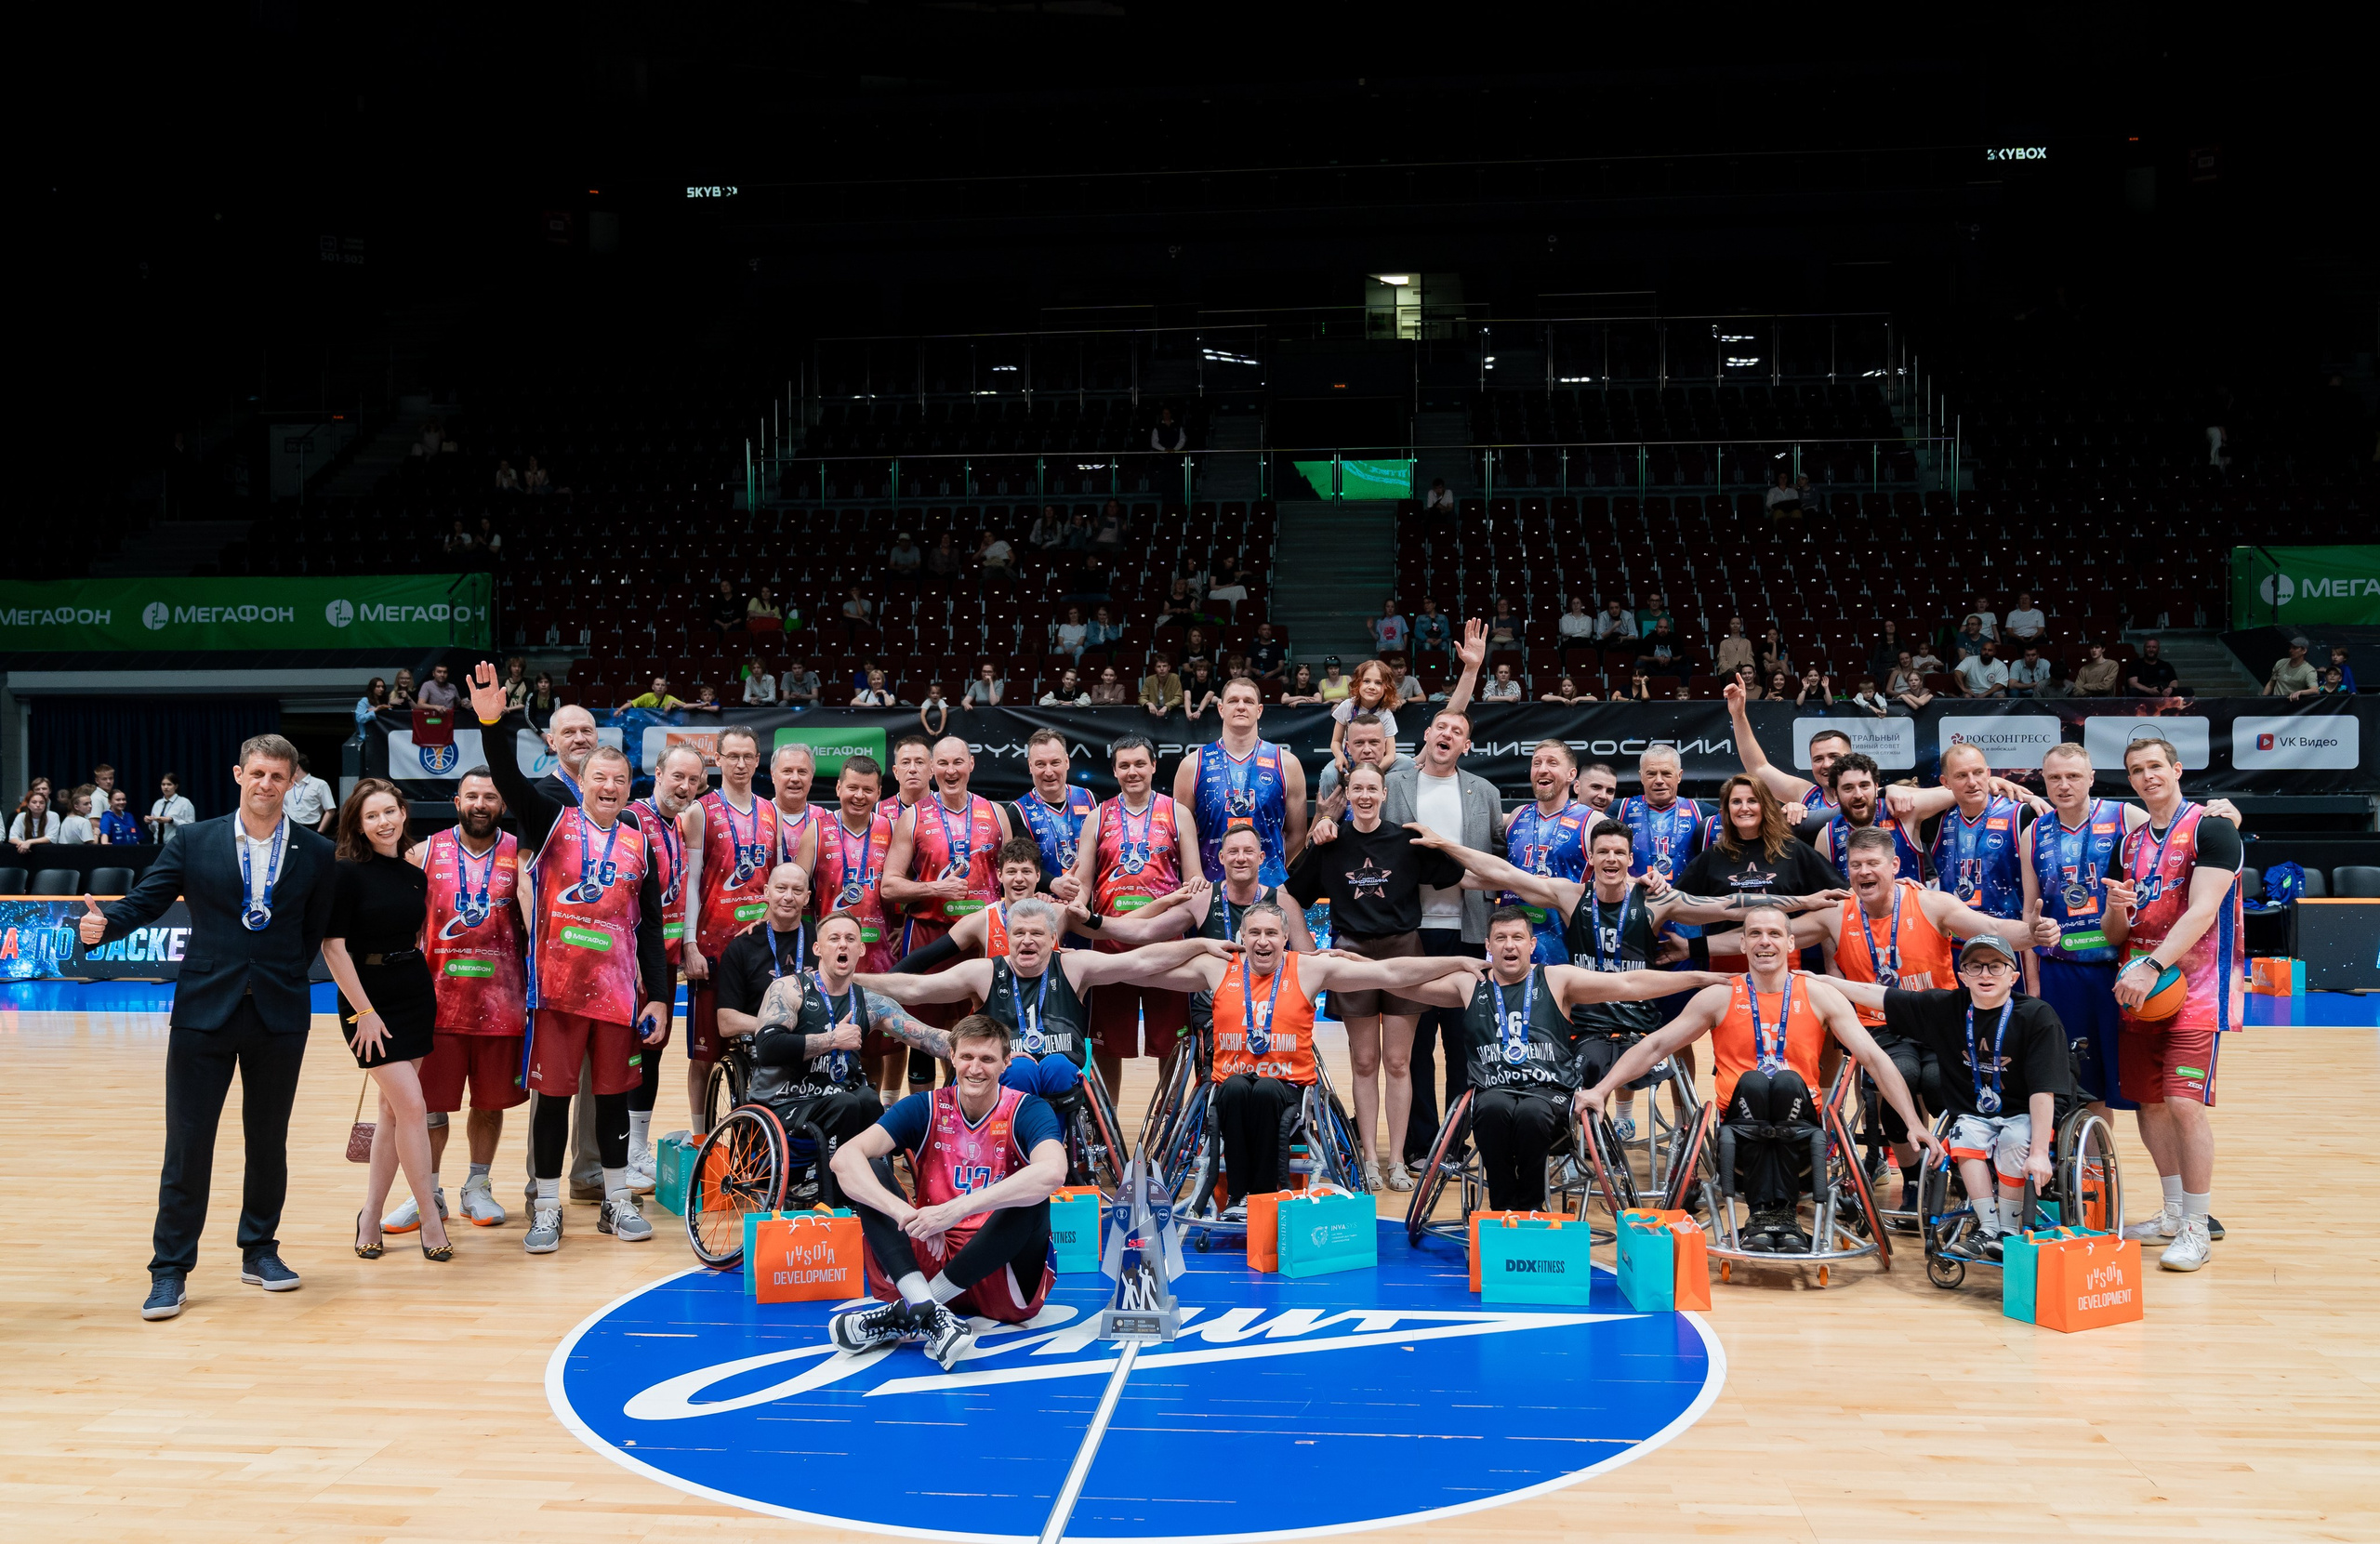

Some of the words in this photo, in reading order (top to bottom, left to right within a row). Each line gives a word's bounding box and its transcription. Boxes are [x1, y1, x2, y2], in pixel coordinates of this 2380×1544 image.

[174, 605, 294, 624] МЕГАФОН
[1850, 733, 1900, 742] ТРАЛЬНЫЙ
[1966, 734, 2051, 744] РОСКОНГРЕСС
[2280, 737, 2296, 746] VK
[2299, 737, 2338, 748] Видео
[34, 928, 74, 961] ПО
[573, 933, 609, 946] МЕГАФОН
[1026, 1003, 1037, 1032] 1
[774, 1267, 848, 1287] DEVELOPMENT
[2078, 1288, 2133, 1312] DEVELOPMENT
